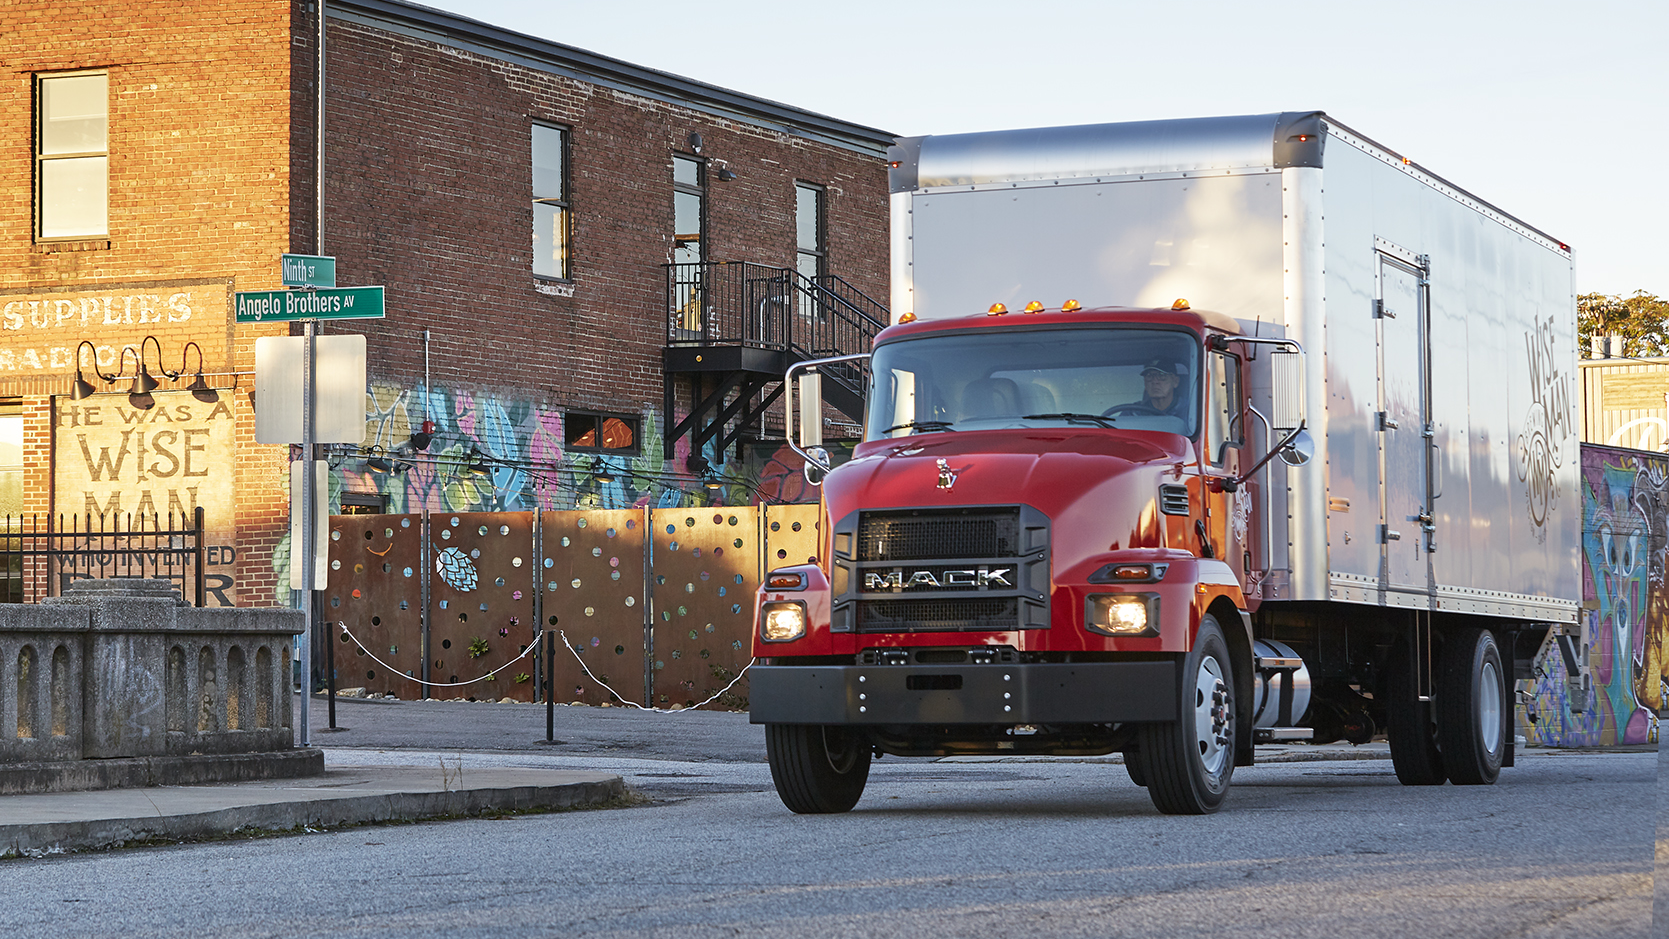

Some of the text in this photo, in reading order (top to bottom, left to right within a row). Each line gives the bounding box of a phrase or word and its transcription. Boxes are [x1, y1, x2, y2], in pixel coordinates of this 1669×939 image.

[283, 258, 316, 282] Ninth ST
[3, 292, 192, 330] SUPPLIES
[238, 292, 355, 321] Angelo Brothers AV
[1524, 314, 1558, 402] WISE
[55, 400, 235, 428] HE WAS A
[1543, 372, 1571, 460] MAN
[76, 427, 210, 485] WISE
[83, 481, 200, 546] MAN
[52, 545, 237, 568] WHO INVENED
[865, 568, 1012, 589] MACK
